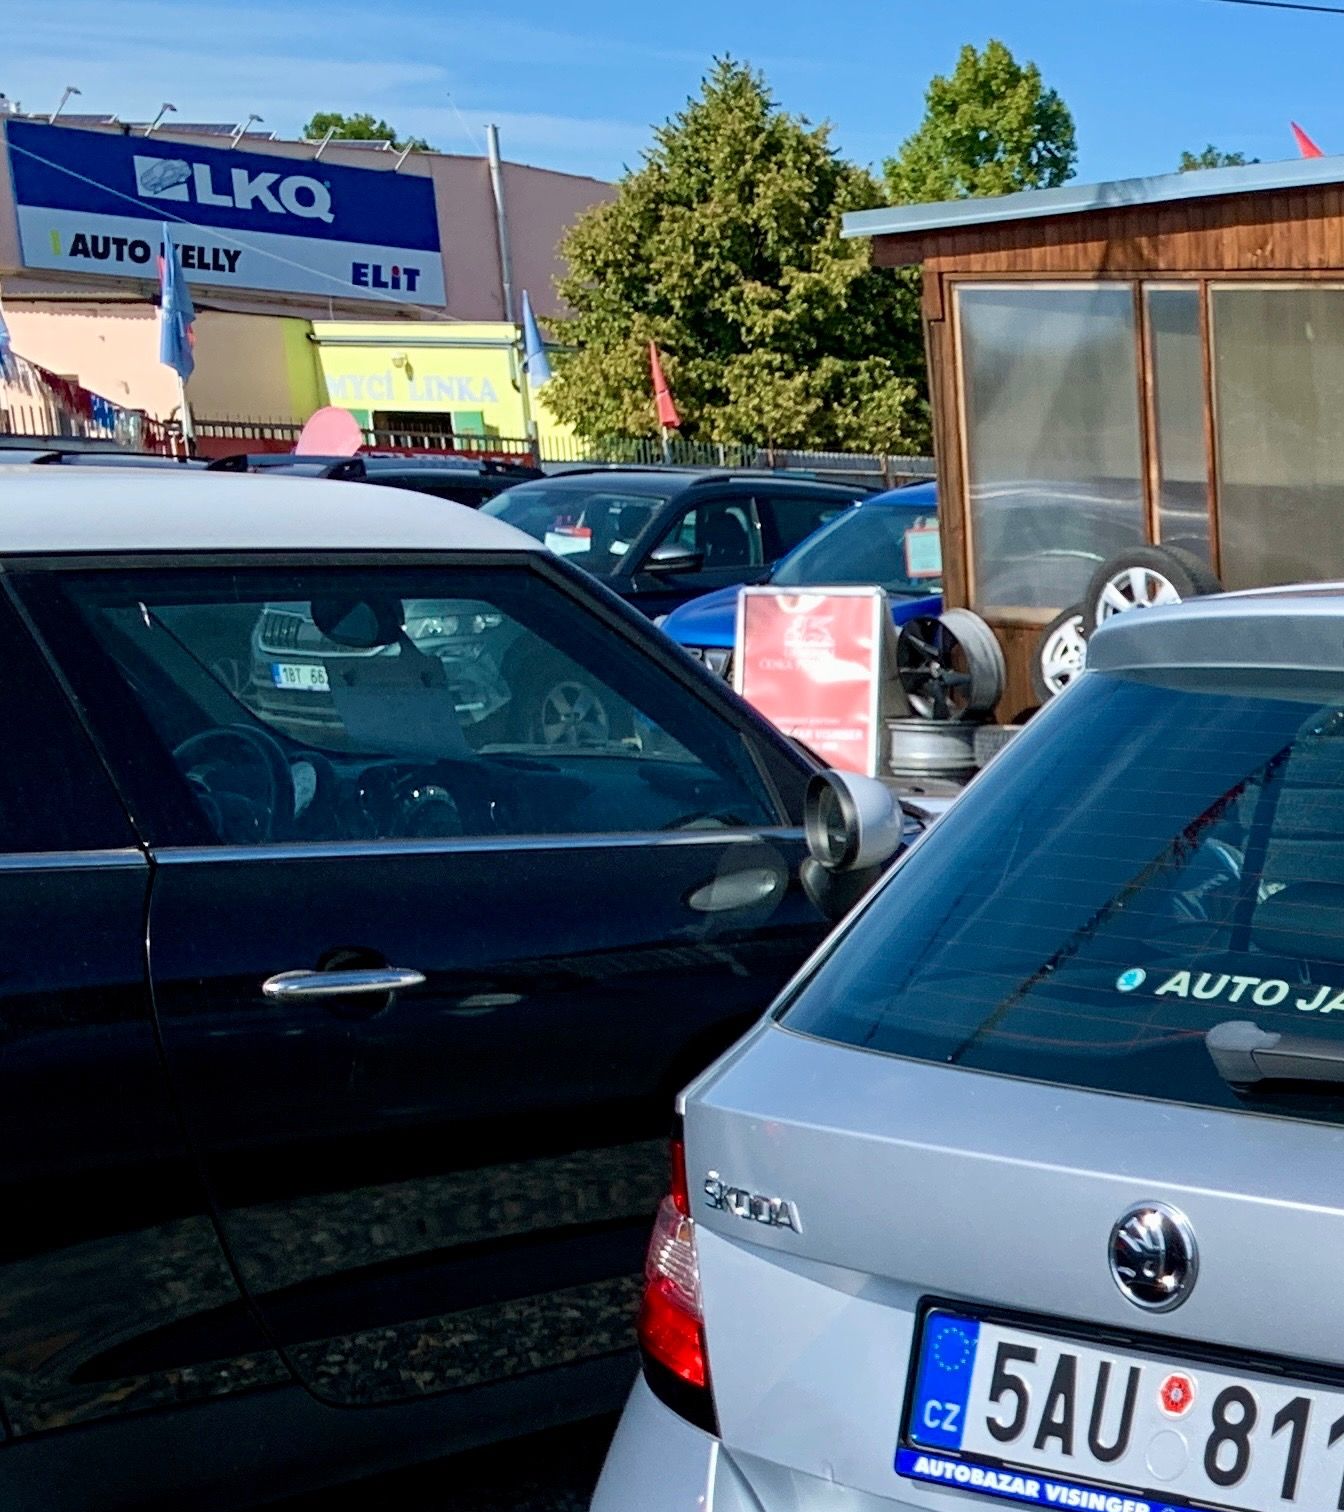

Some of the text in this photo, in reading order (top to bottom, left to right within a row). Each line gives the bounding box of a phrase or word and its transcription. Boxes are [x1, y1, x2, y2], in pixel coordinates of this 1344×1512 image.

[193, 162, 335, 224] LKQ
[69, 233, 150, 264] AUTO
[409, 374, 498, 403] LINKA
[1155, 970, 1290, 1008] AUTO
[923, 1399, 961, 1433] CZ
[985, 1341, 1142, 1463] 5AU
[914, 1456, 1040, 1499] AUTOBAZAR
